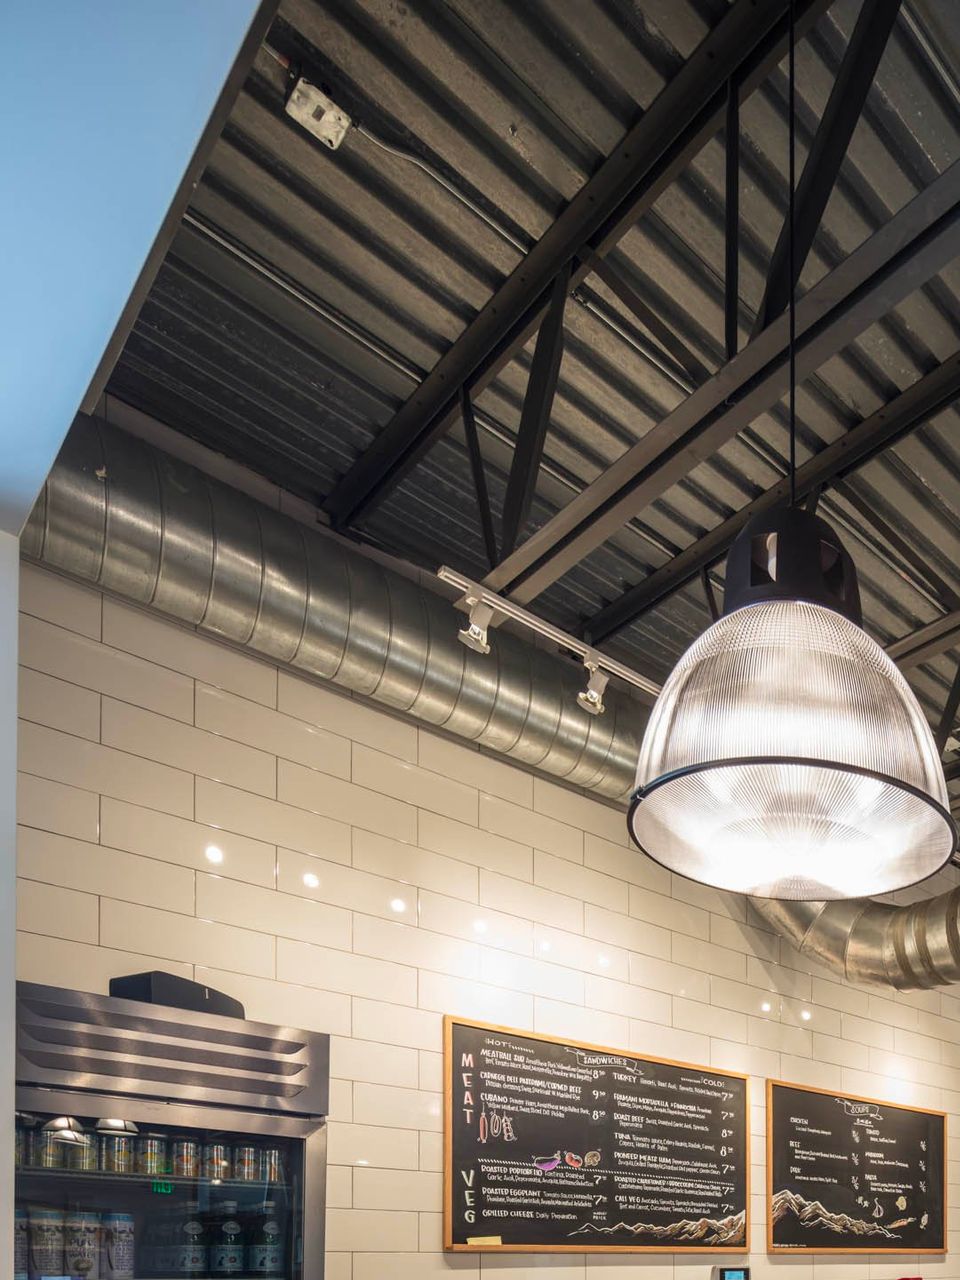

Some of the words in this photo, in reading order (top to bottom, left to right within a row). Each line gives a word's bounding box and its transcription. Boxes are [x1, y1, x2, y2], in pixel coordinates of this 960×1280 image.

[583, 1056, 627, 1066] SANDWICHES
[613, 1072, 637, 1083] TURKEY
[480, 1092, 508, 1103] CUBANO
[613, 1112, 631, 1122] ROAST
[631, 1115, 645, 1123] BEEF
[614, 1132, 632, 1141] TUNA
[789, 1140, 801, 1149] BEEF
[613, 1151, 639, 1161] PIONEER
[481, 1164, 508, 1174] ROASTED
[482, 1186, 509, 1197] ROASTED
[510, 1188, 541, 1198] EGGPLANT
[628, 1195, 641, 1203] VEG
[482, 1209, 509, 1218] GRILLED
[510, 1210, 534, 1219] CHEESE
[535, 1211, 549, 1219] Daily
